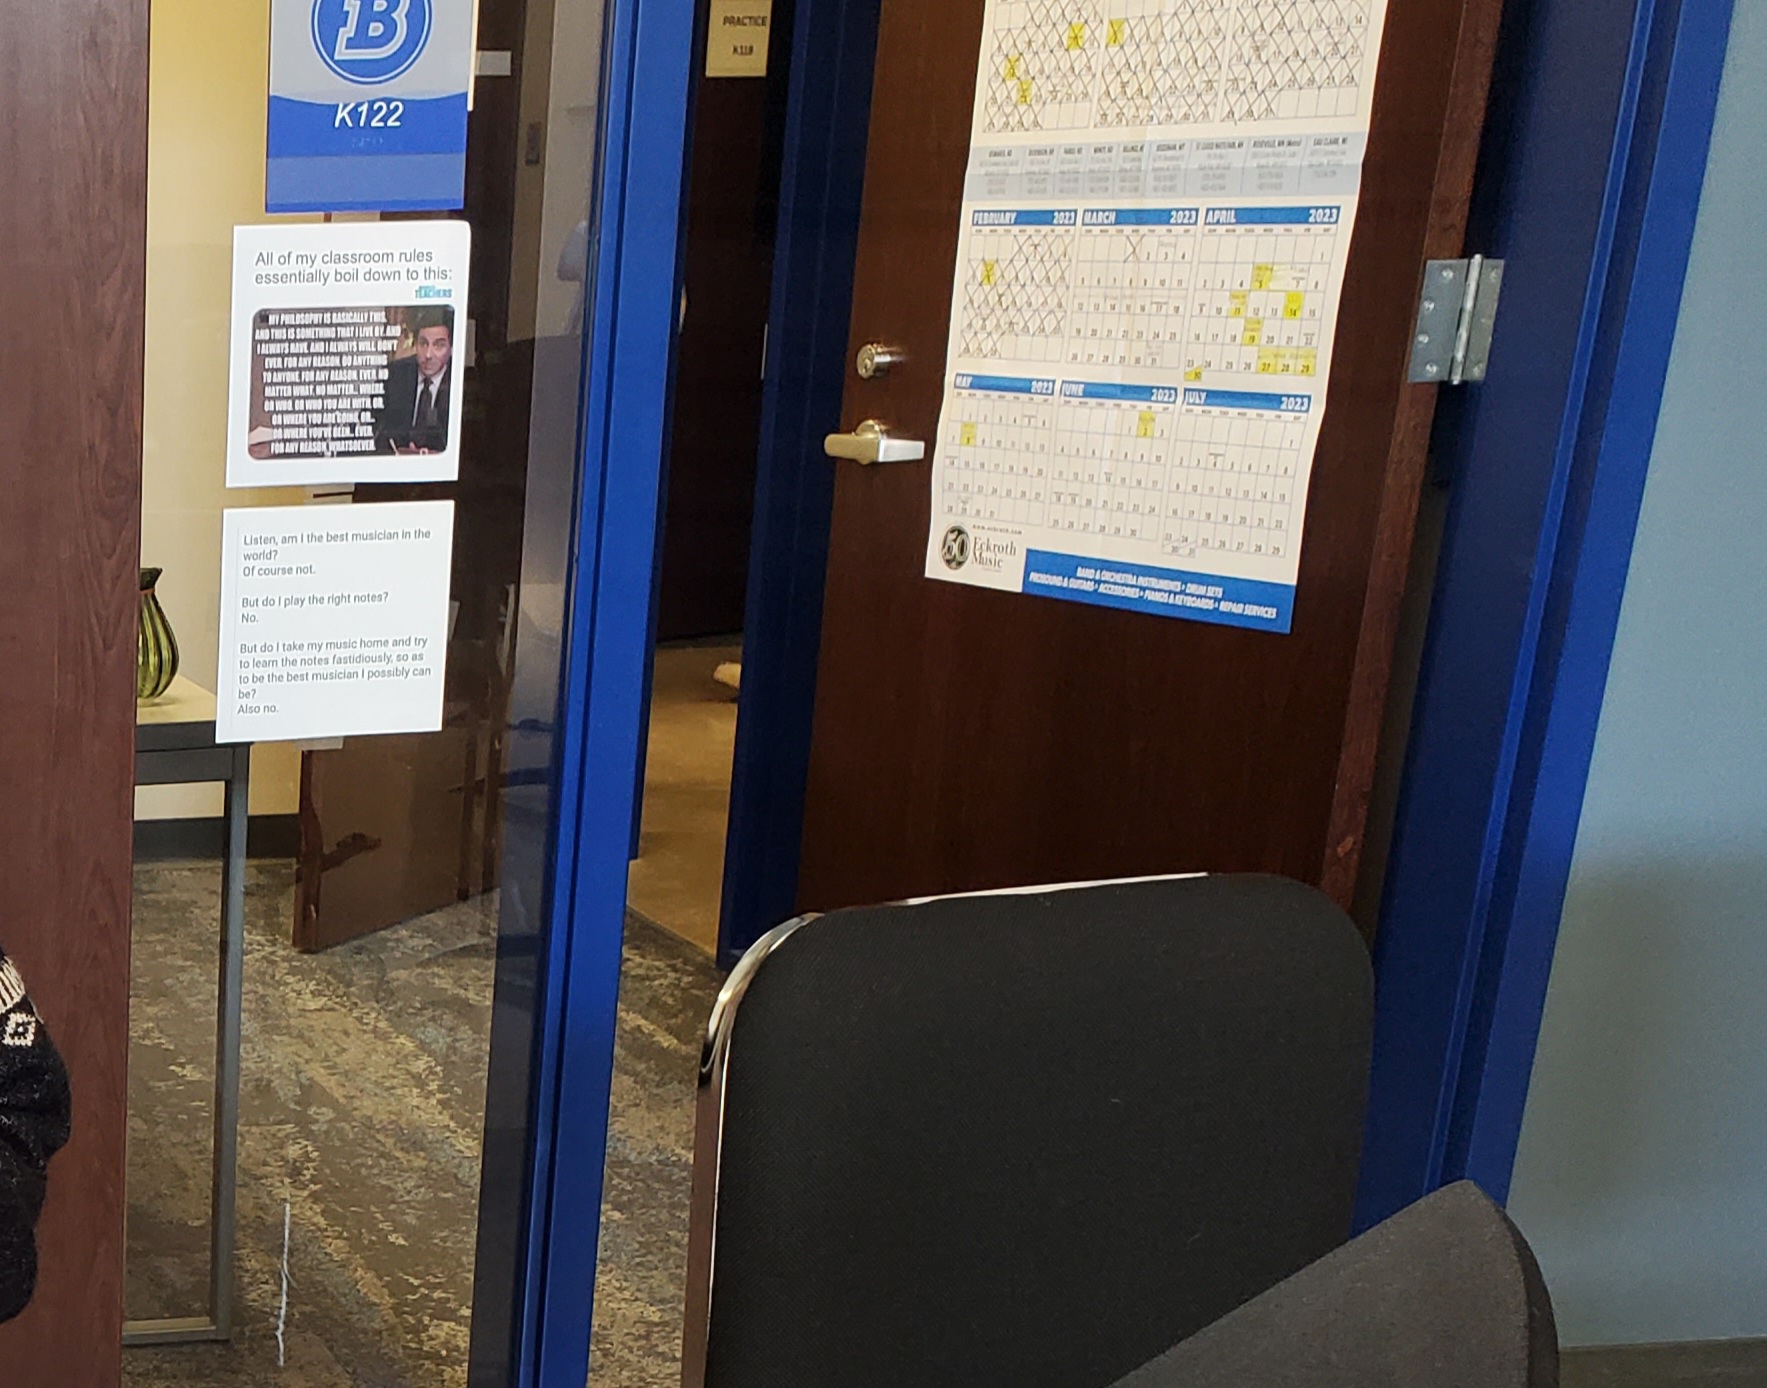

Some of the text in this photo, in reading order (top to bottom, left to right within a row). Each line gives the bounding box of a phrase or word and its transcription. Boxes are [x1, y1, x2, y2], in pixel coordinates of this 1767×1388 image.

[722, 15, 768, 26] PRACTICE
[334, 101, 404, 128] K122
[974, 210, 1075, 224] FEBRUARY 2023
[1084, 210, 1197, 224] MARCH 2023
[1206, 208, 1338, 224] APRIL 2023
[255, 248, 433, 268] All of my classroom rules
[255, 266, 452, 286] essentially boil down to this:
[956, 376, 1053, 394] MAY 2023
[1062, 381, 1085, 396] JUNE
[1150, 388, 1176, 402] 2023
[1184, 390, 1308, 410] JULY 2023
[243, 528, 430, 546] Listen, am I the best musician in the
[243, 548, 277, 561] world?
[973, 536, 1016, 556] Eckroth
[972, 551, 1004, 568] Music
[242, 564, 315, 576] Of course not.
[241, 591, 388, 608] But do I play the right notes?
[241, 612, 258, 623] No.
[240, 636, 427, 654] But do I take my music home and try
[239, 652, 423, 669] to learn the notes fastidiously, so as
[238, 666, 430, 684] to be the best musician I possibly can
[238, 688, 256, 699] be?
[237, 703, 278, 714] Also no.
